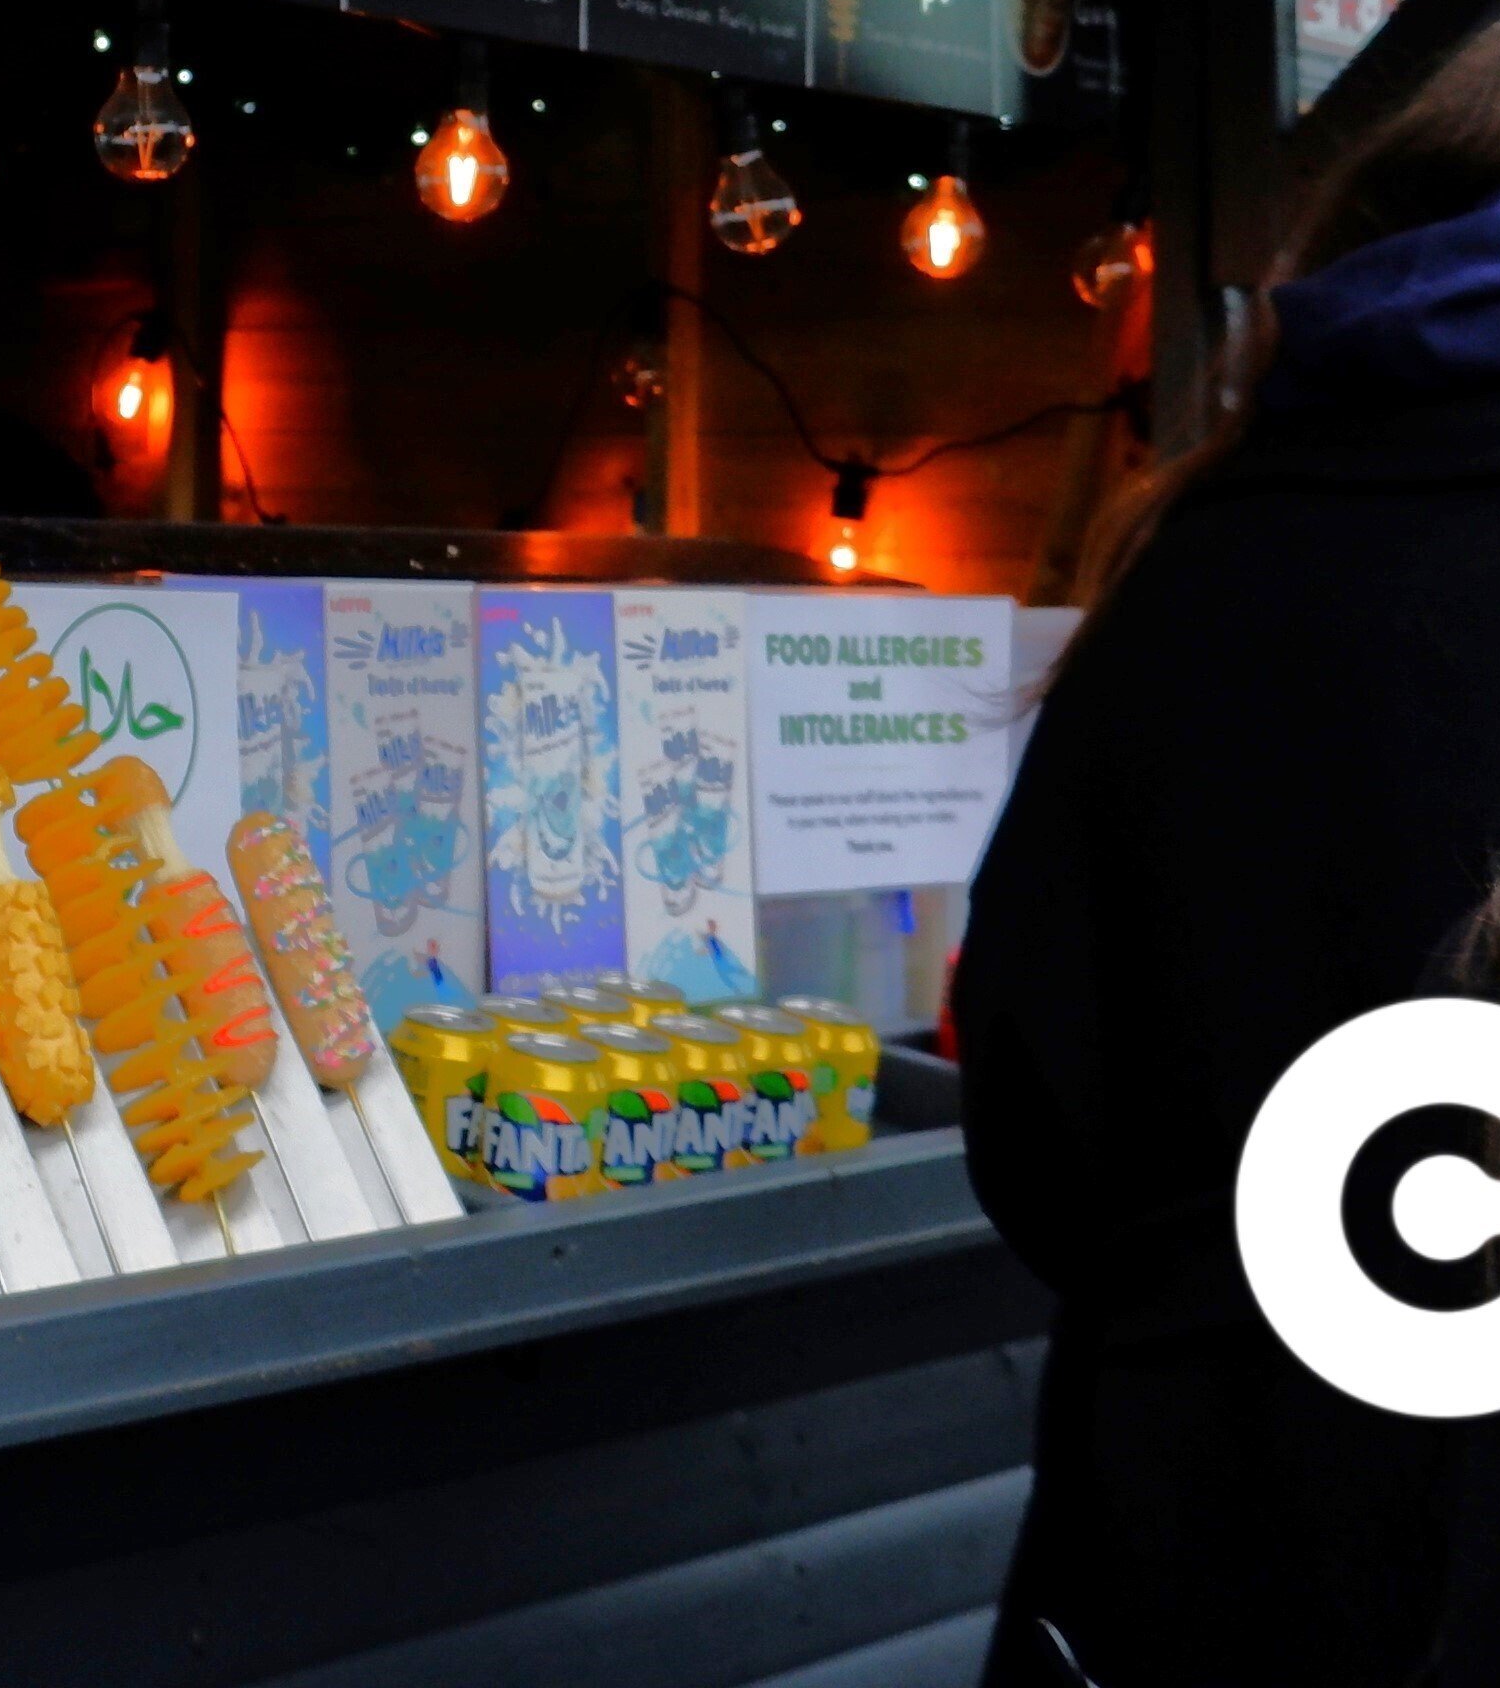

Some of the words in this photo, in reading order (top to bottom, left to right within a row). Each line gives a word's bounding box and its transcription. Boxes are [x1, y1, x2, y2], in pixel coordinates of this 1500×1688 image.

[765, 633, 831, 666] FOOD
[837, 634, 984, 667] ALLERGIES
[778, 712, 969, 746] INTOLERANCES
